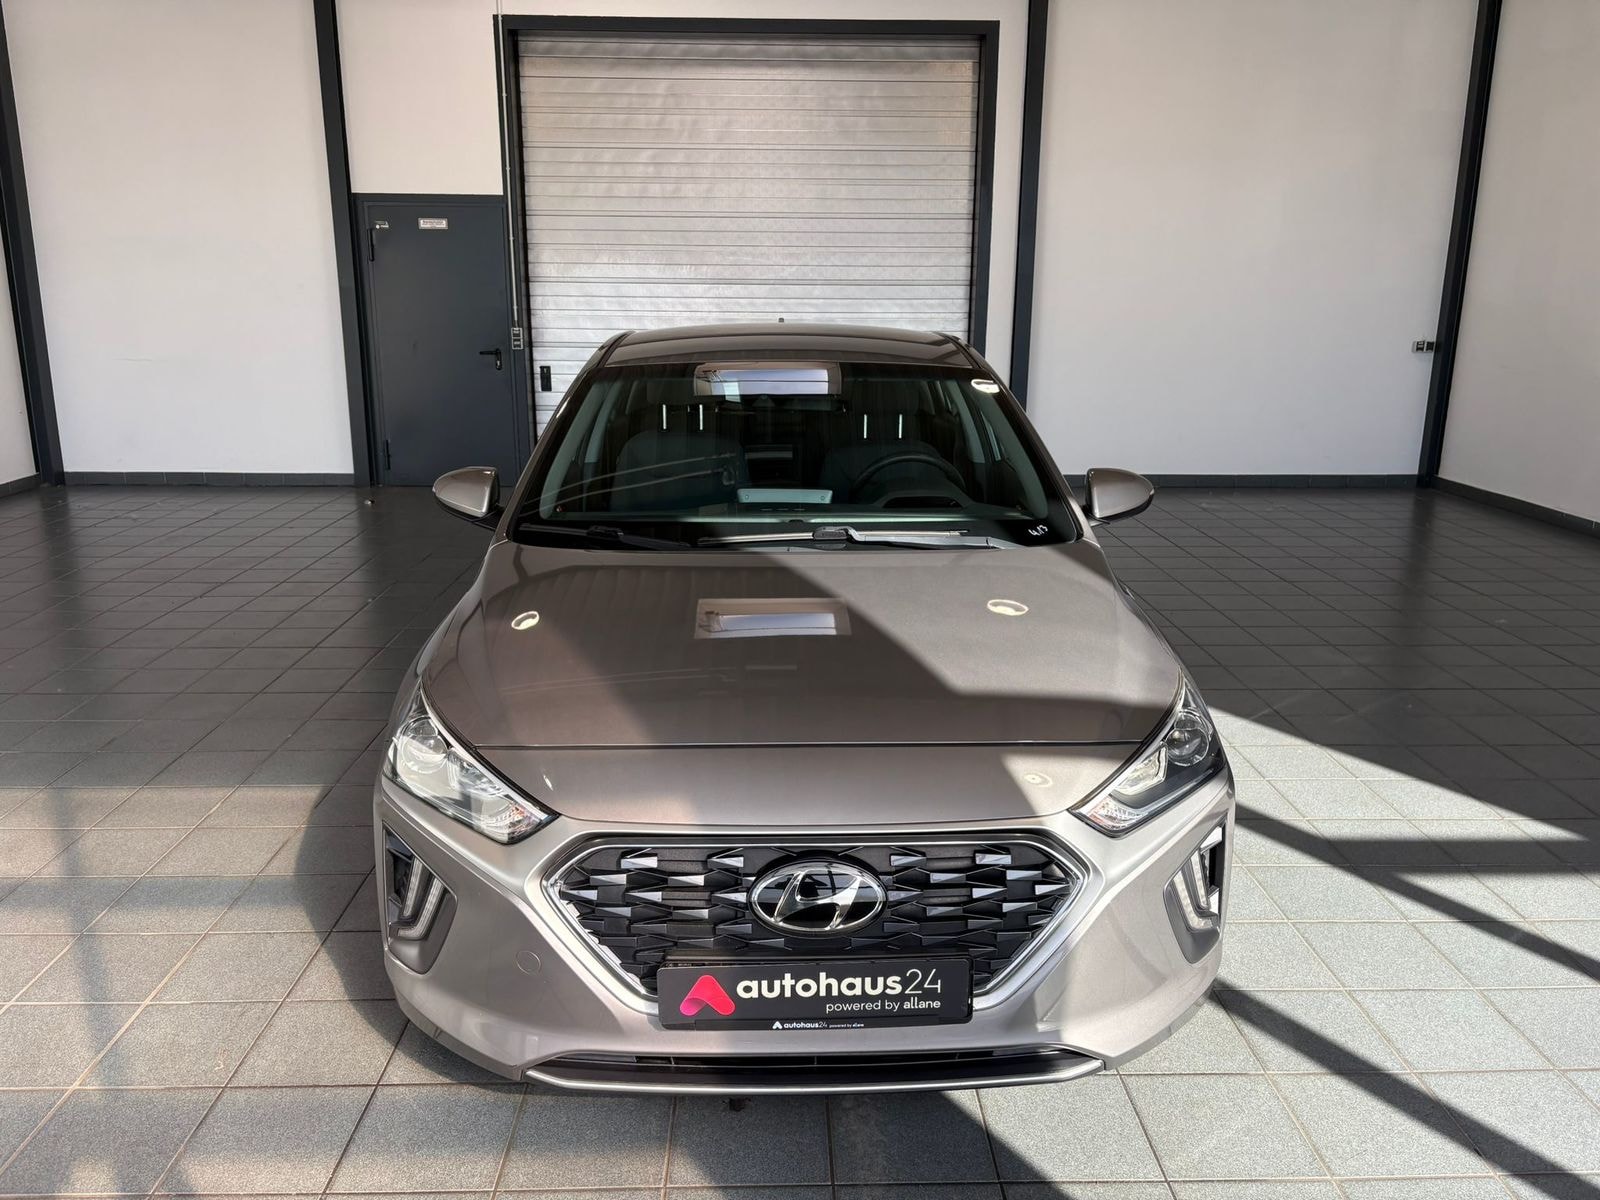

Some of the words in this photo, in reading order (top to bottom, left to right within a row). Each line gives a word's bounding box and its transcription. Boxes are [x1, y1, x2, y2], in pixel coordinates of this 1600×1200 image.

[736, 968, 942, 999] autohaus24
[826, 999, 881, 1014] powered
[885, 998, 901, 1011] by
[903, 997, 941, 1010] allane
